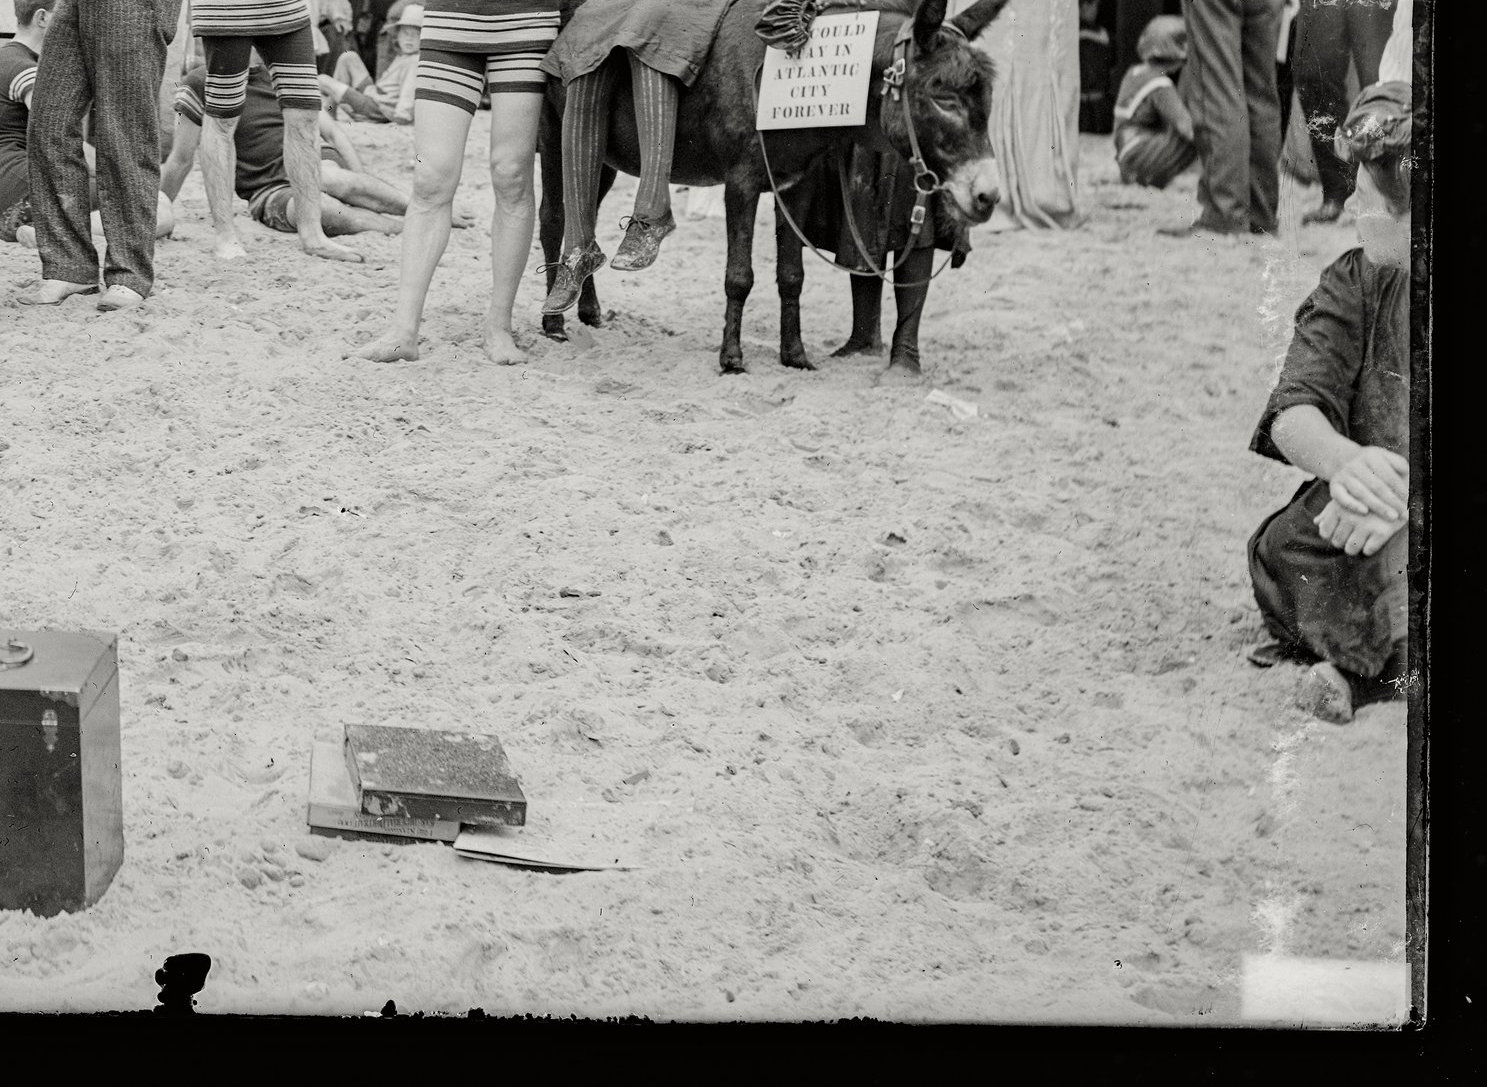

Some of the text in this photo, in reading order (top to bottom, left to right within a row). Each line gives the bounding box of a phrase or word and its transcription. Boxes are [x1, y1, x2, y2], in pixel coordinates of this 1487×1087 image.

[812, 24, 866, 39] COULD
[784, 43, 853, 60] STAY IN
[773, 63, 860, 80] ATLANTIC
[790, 84, 831, 98] CITY
[772, 103, 851, 119] FOREVER
